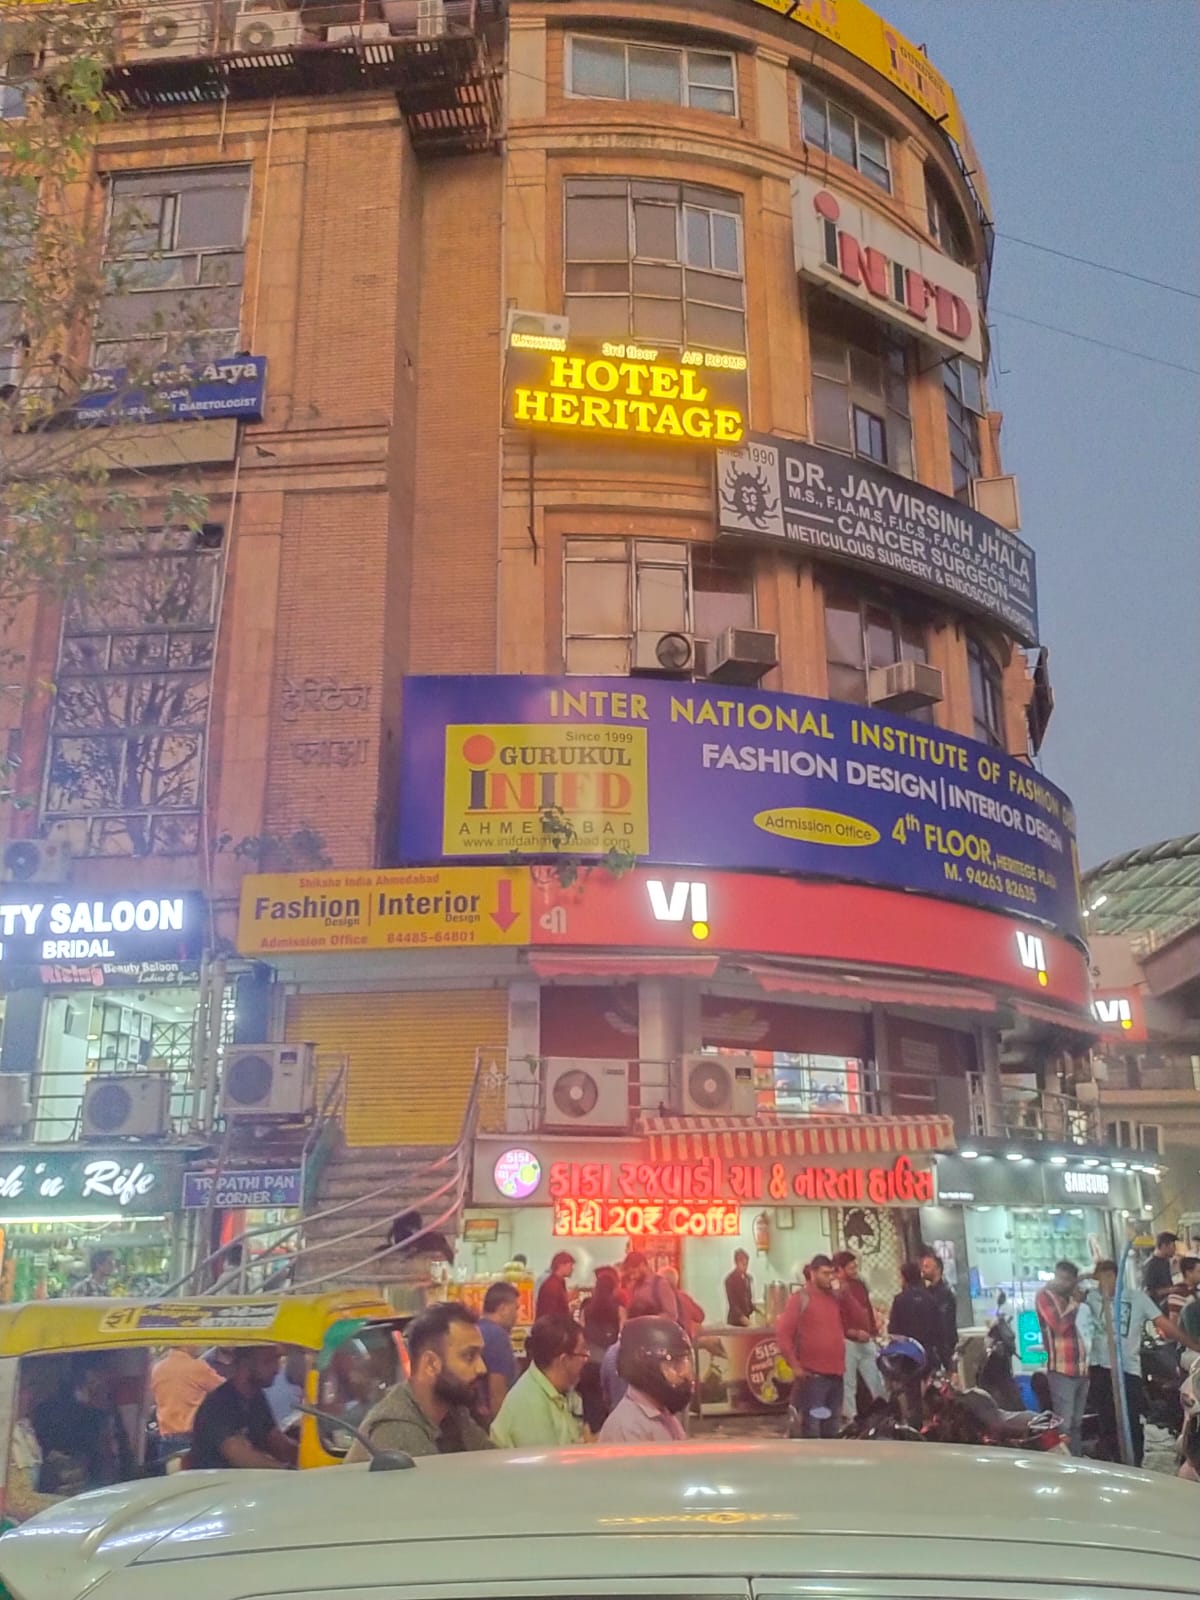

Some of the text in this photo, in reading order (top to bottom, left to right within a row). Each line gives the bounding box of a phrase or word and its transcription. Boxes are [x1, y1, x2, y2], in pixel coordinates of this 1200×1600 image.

[203, 362, 257, 385] Arya
[705, 353, 747, 370] ROOMS
[550, 356, 708, 402] HOTEL
[179, 397, 257, 412] DIABETOLOGIST
[514, 388, 744, 441] HERITAGE
[747, 447, 775, 467] 1990
[785, 457, 833, 493] DR.
[840, 475, 973, 546] JAYVIRSINH
[978, 532, 1030, 582] JHALA
[786, 523, 1001, 613] METICULOUS SURGERY & ENDOSCOPY
[838, 516, 1008, 600] CANCER SURGEON
[566, 731, 633, 743] Since 1999
[500, 746, 632, 767] GURUKUL
[551, 690, 1060, 817] INTER NATIONAL INSTITUTE OF FASHION
[702, 743, 838, 782] FASHION
[847, 760, 938, 803] DESIGN
[949, 784, 1024, 833] INTERIOR
[1025, 814, 1062, 852] DESIGN
[765, 814, 872, 841] Admission Office
[892, 813, 920, 844] 4th
[925, 824, 996, 870] FLOOR,
[300, 874, 440, 888] Shiksha India Ahmedabad
[944, 862, 962, 882] M.
[966, 867, 1003, 892] 94263
[50, 898, 184, 935] SALOON
[255, 891, 481, 920] Fashion Interior
[324, 913, 480, 927] Design Design
[42, 939, 115, 960] BRIDAL
[261, 935, 326, 948] Admission
[330, 934, 368, 946] Office
[103, 963, 140, 975] Beauty
[142, 962, 178, 972] Saloon
[82, 1160, 155, 1205] Rife
[194, 1175, 294, 1190] TRPATHI PAN
[550, 1160, 613, 1198] કાકા
[618, 1156, 723, 1198] રજવાડી
[729, 1165, 763, 1198] ચા
[769, 1162, 788, 1199] &
[868, 1155, 934, 1204] હાઉસ
[1064, 1171, 1110, 1195] SAMSUNG
[216, 1191, 271, 1205] CORNER
[668, 1206, 738, 1235] Coffe
